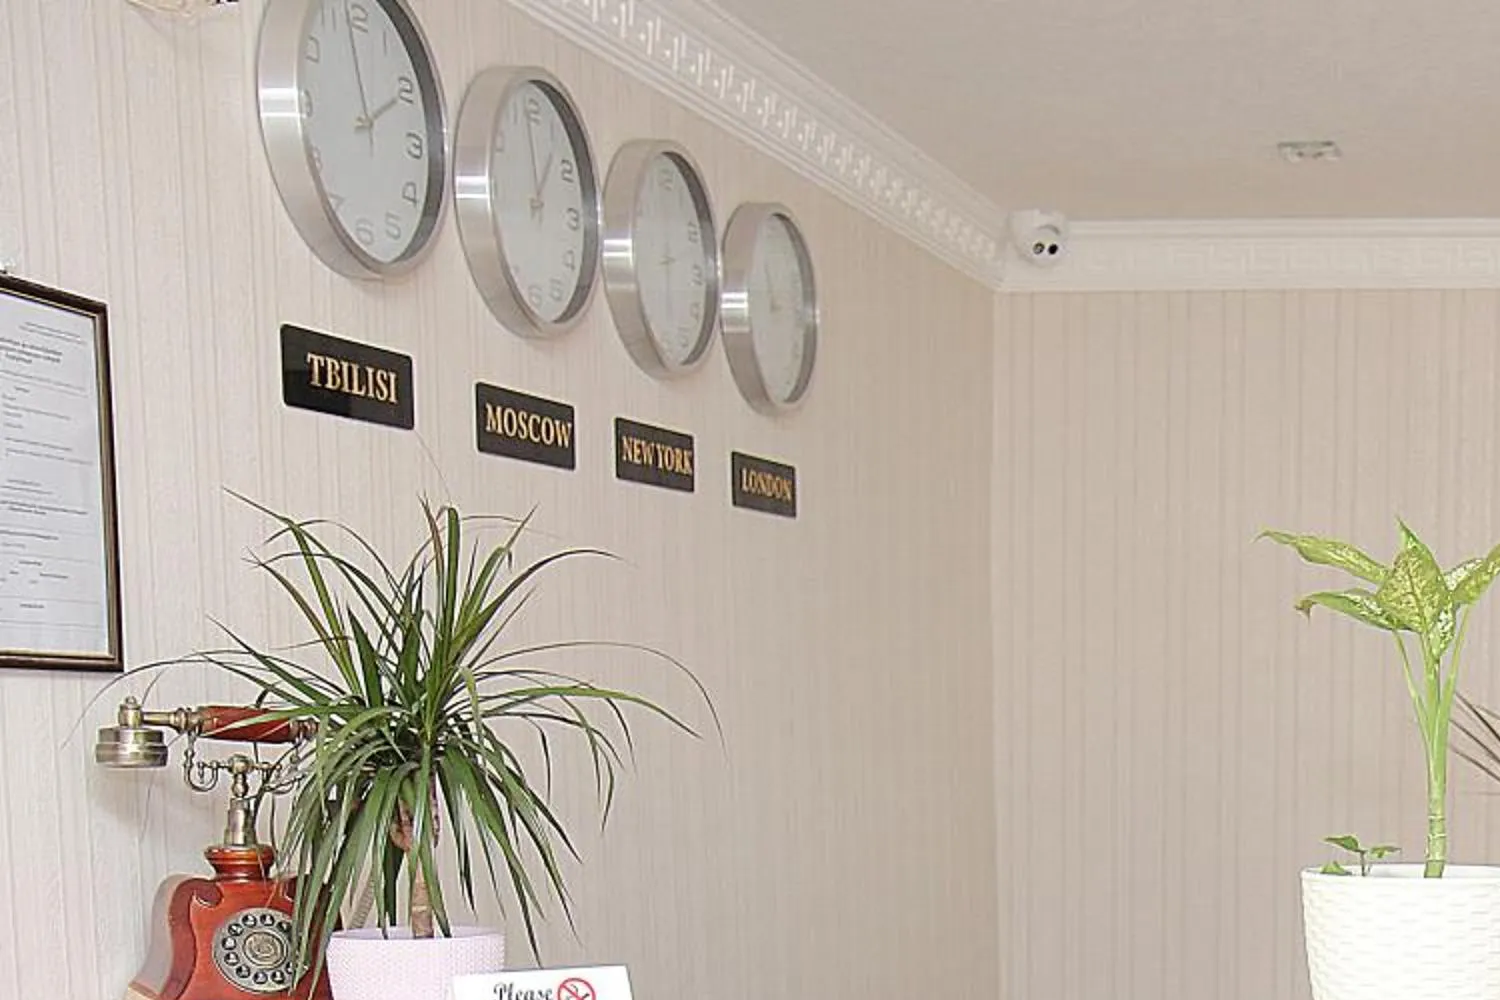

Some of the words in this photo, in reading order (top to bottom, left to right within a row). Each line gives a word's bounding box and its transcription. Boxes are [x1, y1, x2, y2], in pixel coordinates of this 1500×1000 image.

[306, 352, 398, 405] TBILISI
[485, 402, 573, 449] MOSCOW
[621, 435, 653, 467] NEW
[654, 441, 693, 475] YORK
[741, 467, 793, 501] LONDON
